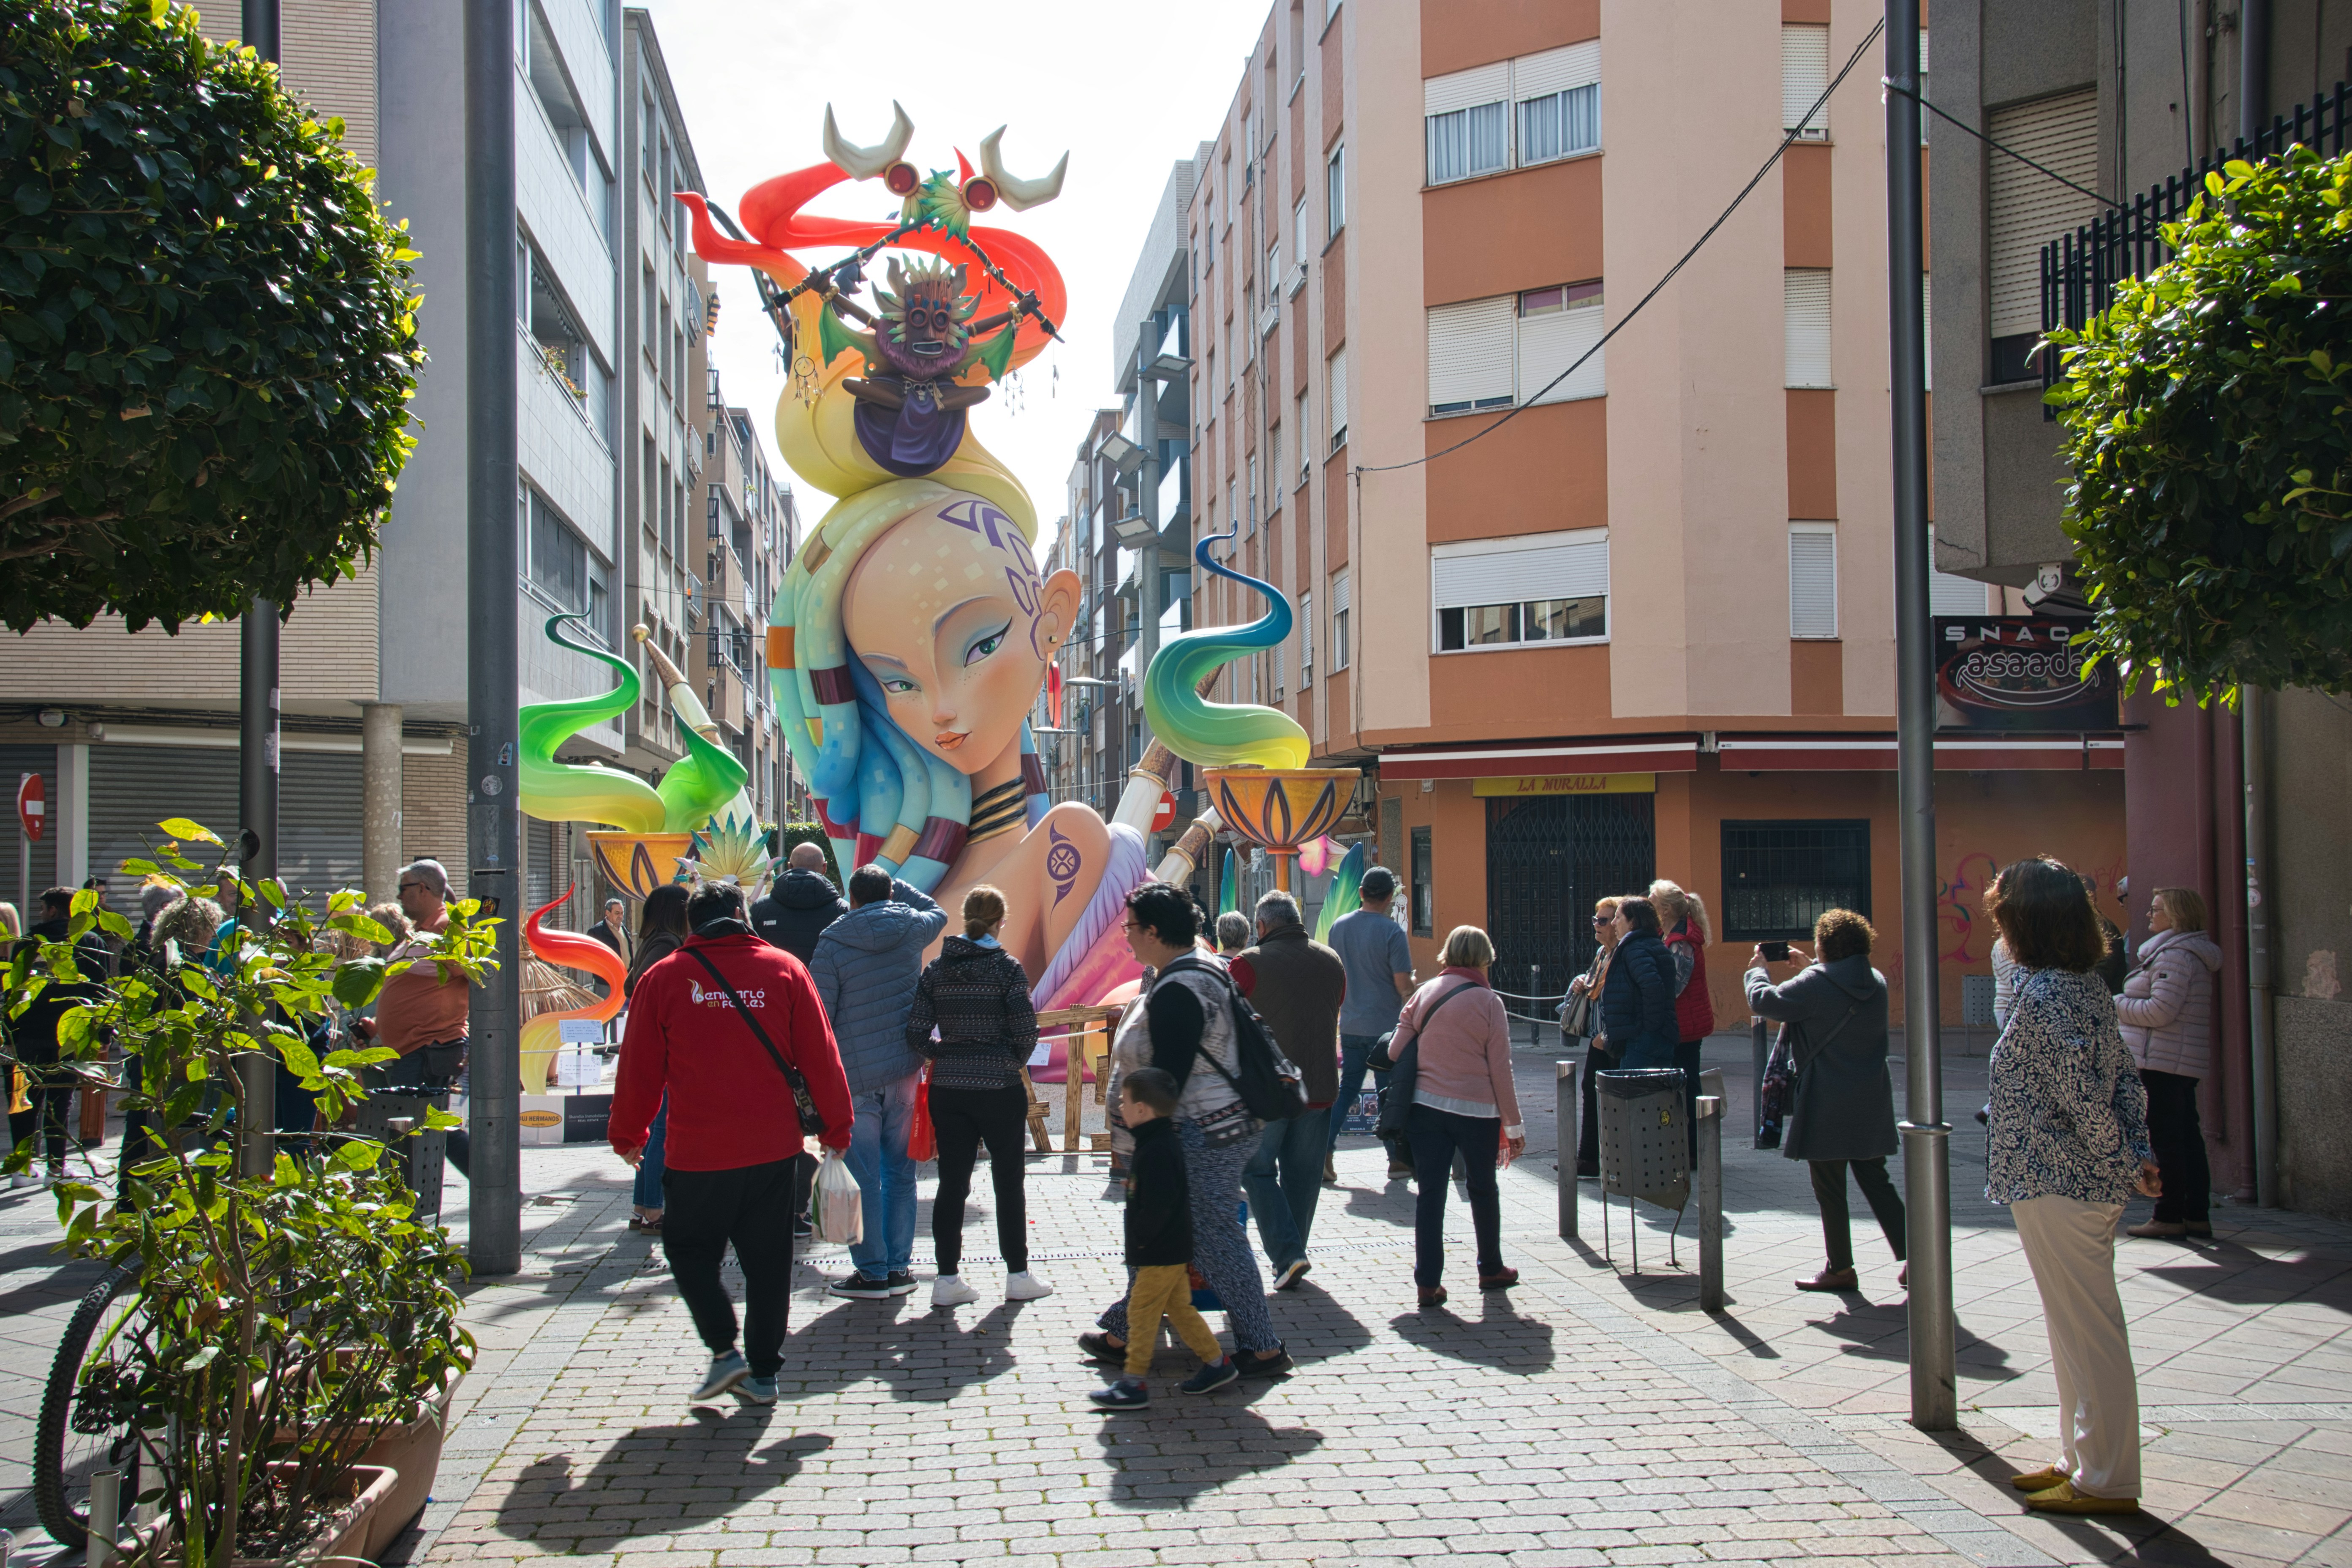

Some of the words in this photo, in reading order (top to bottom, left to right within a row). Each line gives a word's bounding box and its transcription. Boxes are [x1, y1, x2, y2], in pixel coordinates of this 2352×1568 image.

[1945, 626, 2102, 641] SNAC
[1517, 779, 1535, 792] LA
[1542, 777, 1606, 791] MURALLA
